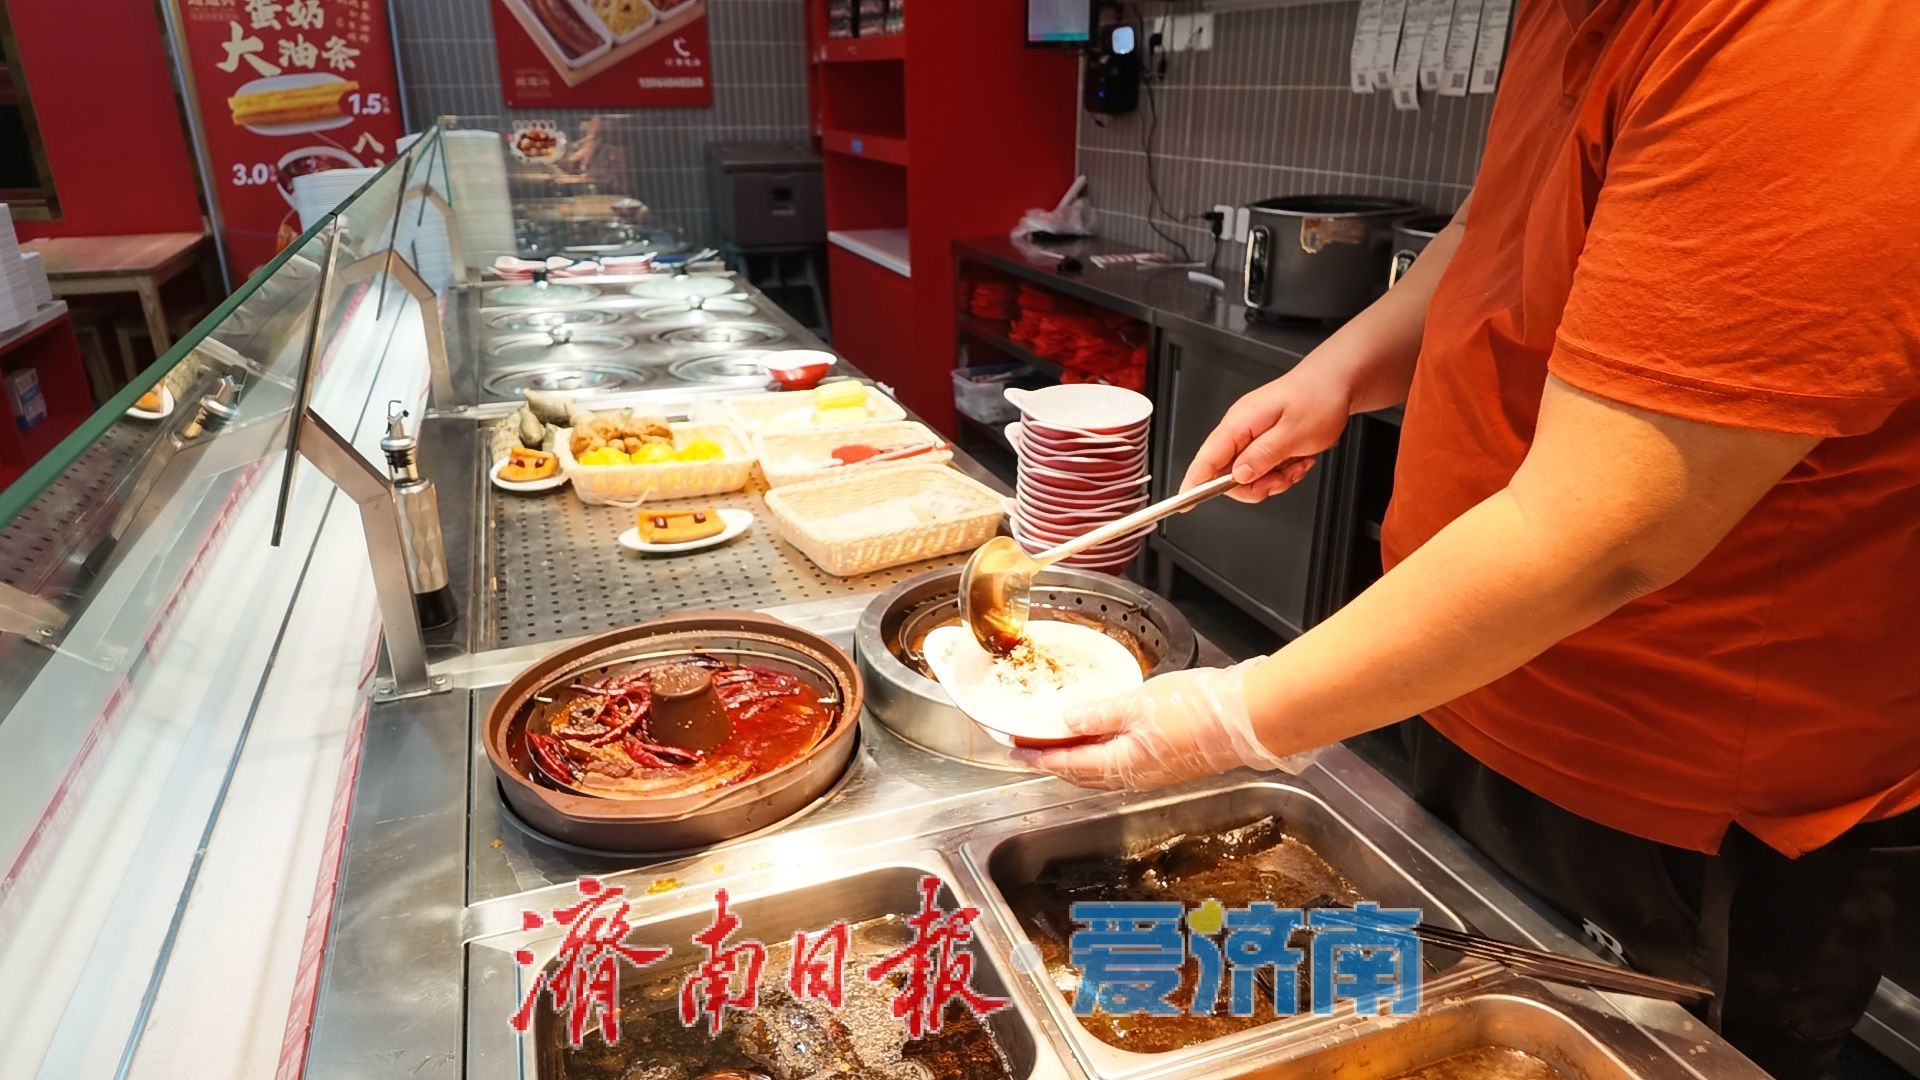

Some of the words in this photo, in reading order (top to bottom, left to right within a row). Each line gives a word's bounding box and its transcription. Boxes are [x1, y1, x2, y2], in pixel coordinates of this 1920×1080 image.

[245, 0, 324, 30] 蛋奶
[216, 21, 360, 78] 大油条
[348, 93, 381, 115] 1.5
[232, 162, 268, 186] 3.0
